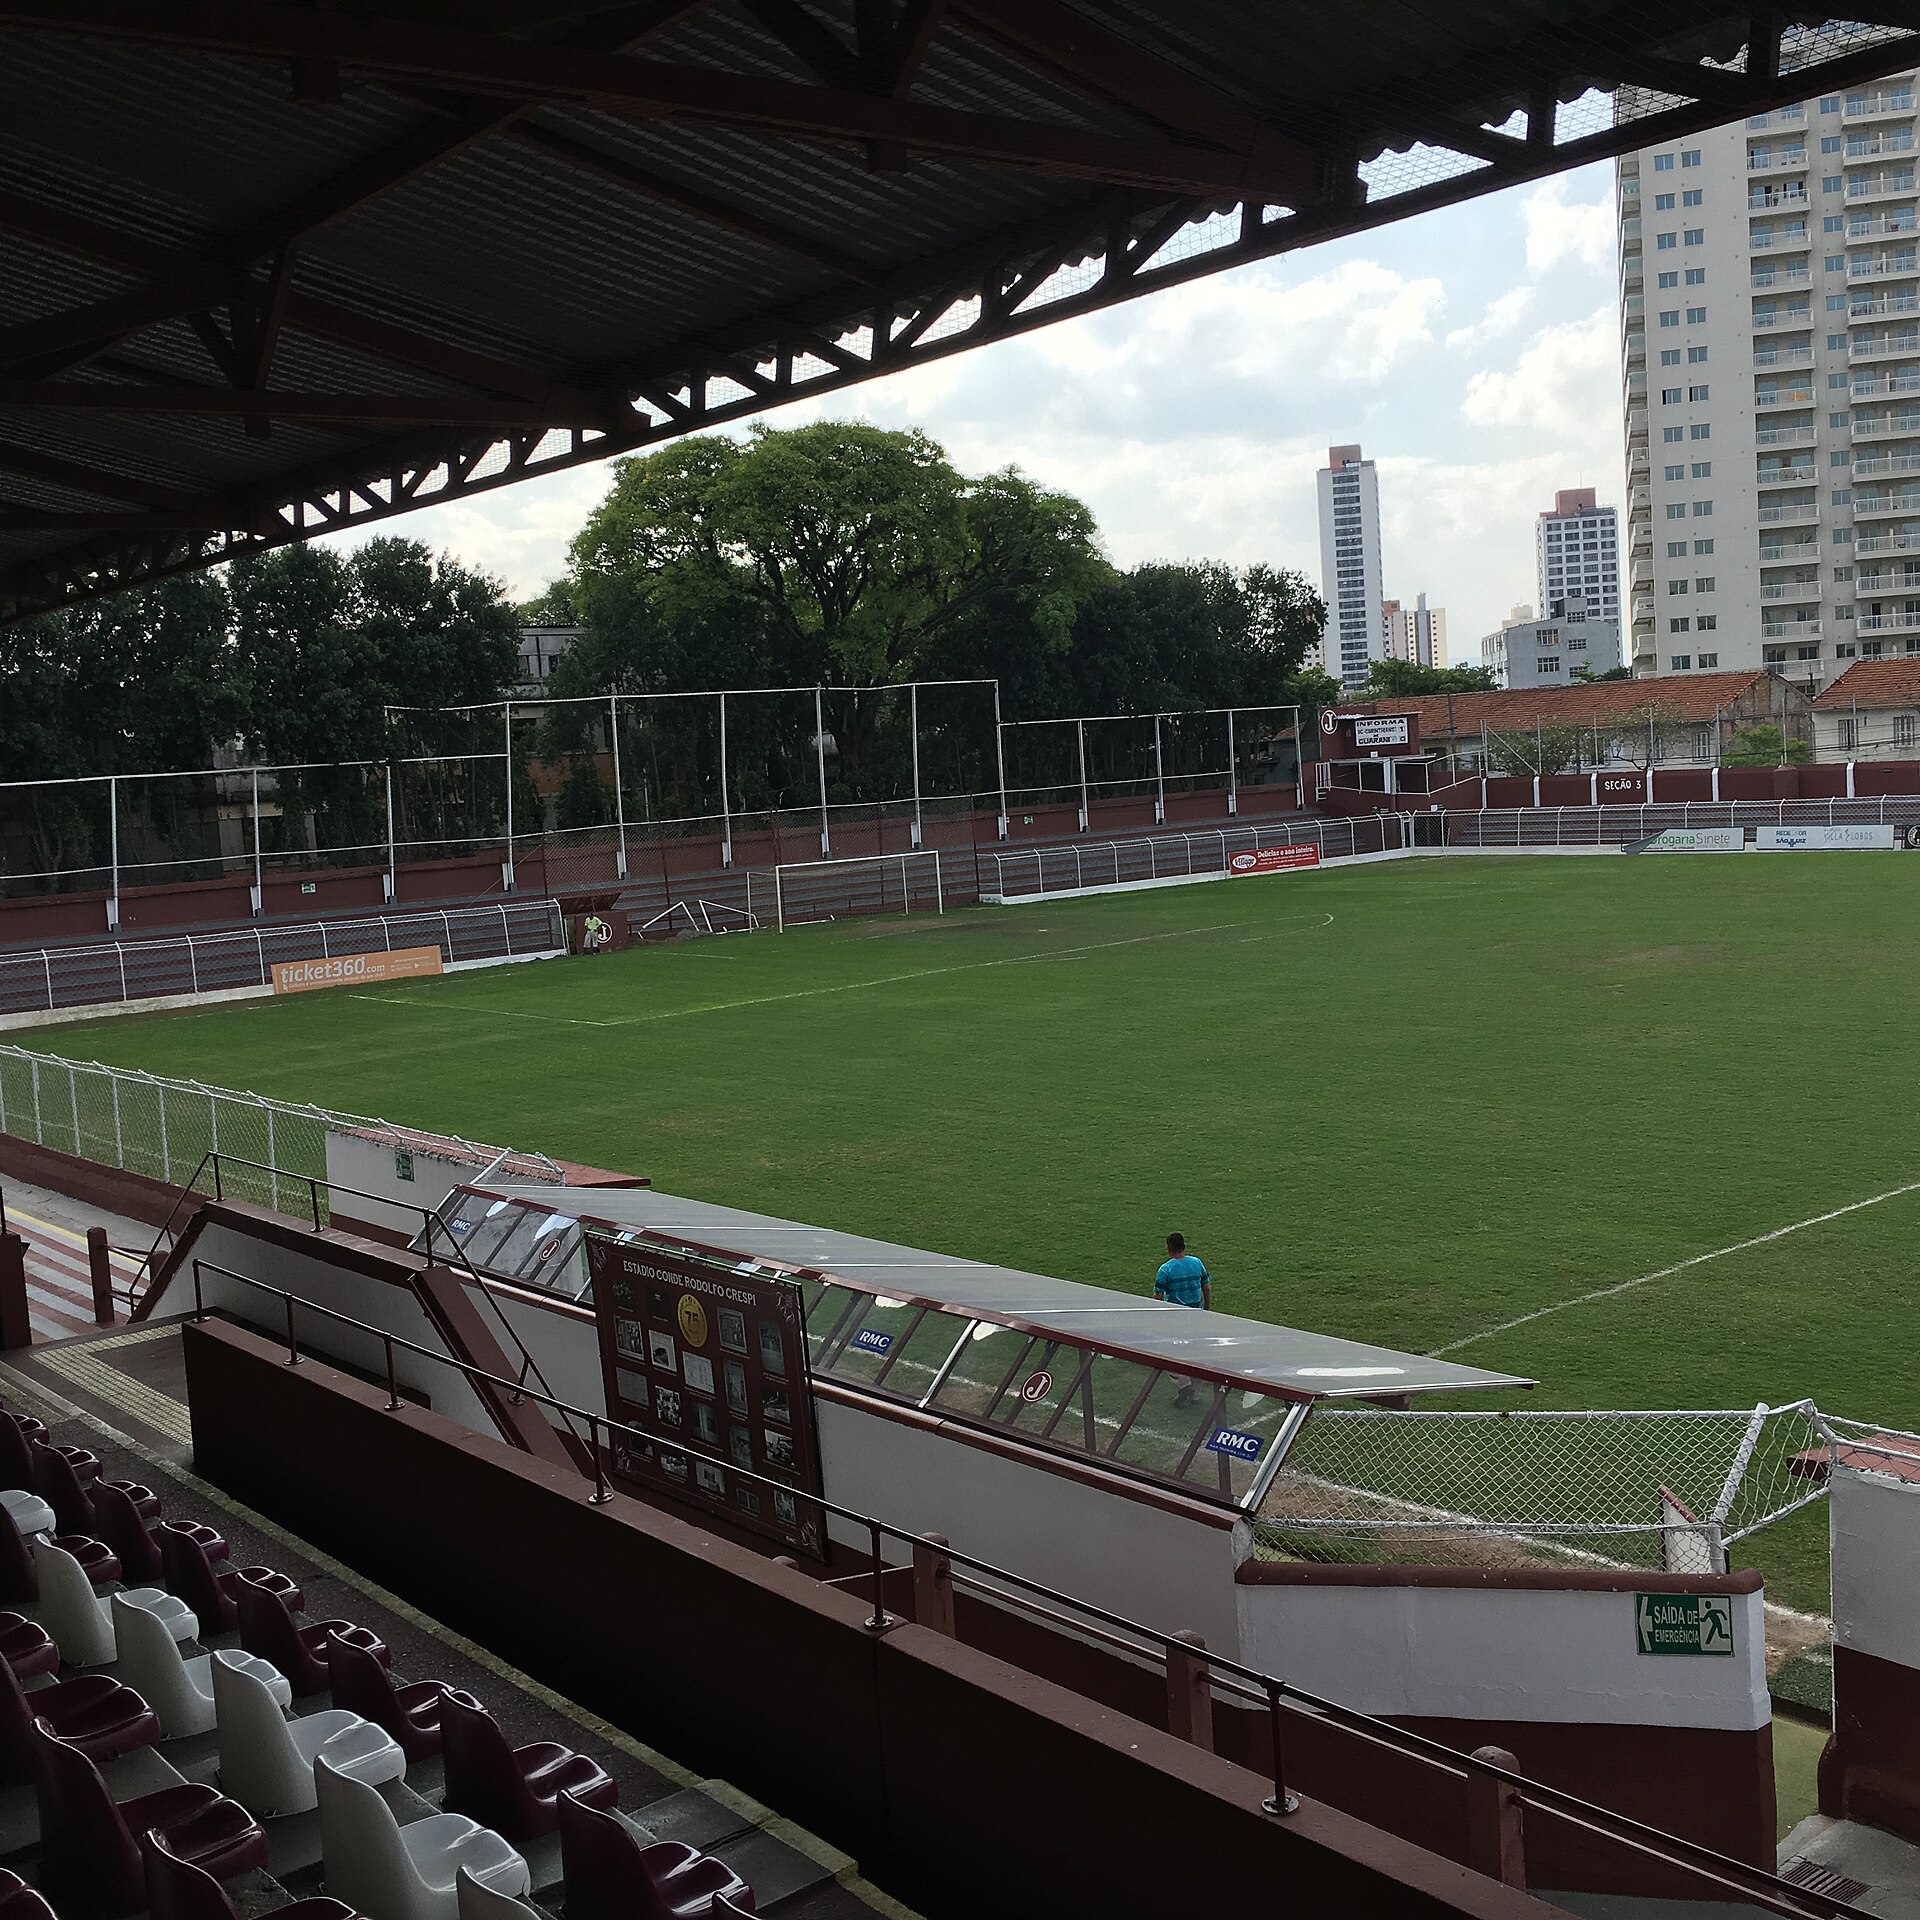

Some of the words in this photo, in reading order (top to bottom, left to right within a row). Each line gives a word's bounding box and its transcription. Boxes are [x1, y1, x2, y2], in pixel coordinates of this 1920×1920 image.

[1356, 719, 1405, 727] INFORMA
[1358, 736, 1391, 744] GUARANI
[1604, 777, 1632, 791] SEÇÃO
[1635, 779, 1642, 790] 3
[451, 1219, 471, 1231] RMC
[656, 1269, 684, 1287] CONDE
[684, 1276, 725, 1297] RODOLFO
[725, 1287, 757, 1306] CRESPI
[859, 1331, 890, 1348] RMC
[1216, 1431, 1259, 1452] RMC
[1653, 1601, 1686, 1625] SAÍDA
[1687, 1610, 1699, 1625] DE
